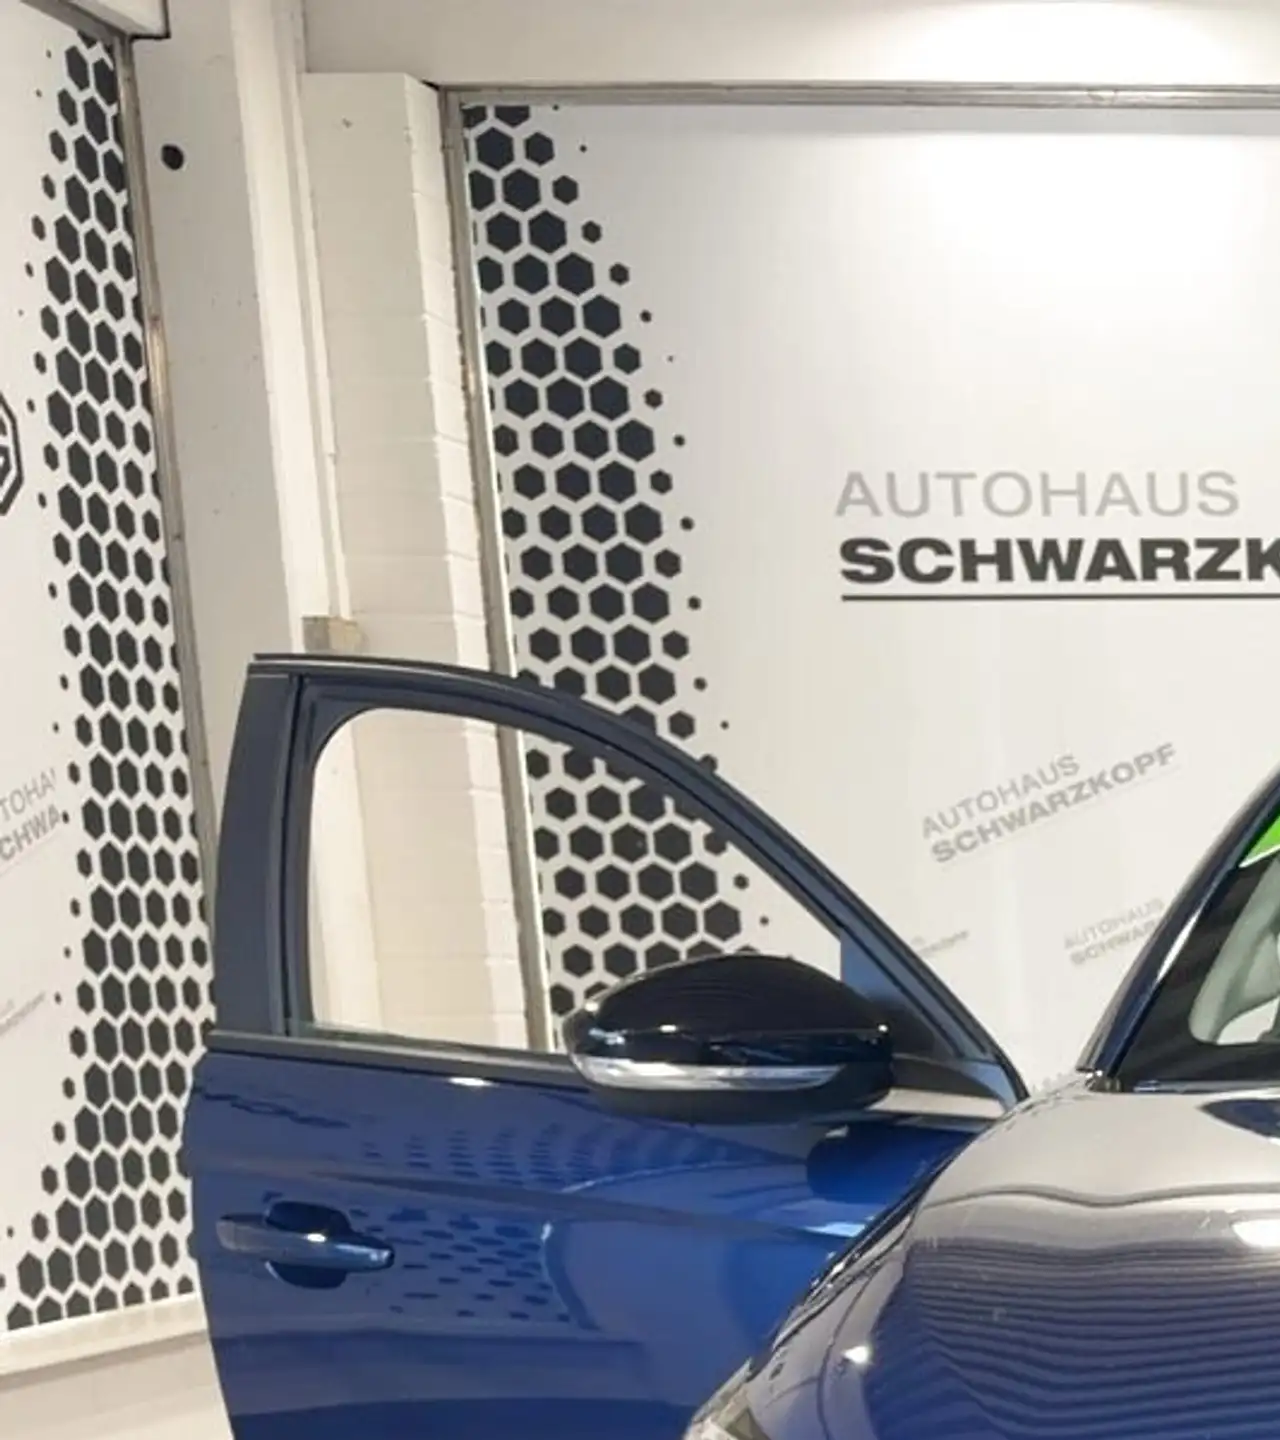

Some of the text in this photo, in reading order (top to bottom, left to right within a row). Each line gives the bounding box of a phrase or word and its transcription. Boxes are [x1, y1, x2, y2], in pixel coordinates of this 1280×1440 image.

[834, 471, 1240, 518] AUTOHAUS
[922, 754, 1080, 839] AUTOHAUS
[931, 742, 1176, 863] SCHWARZKOPF
